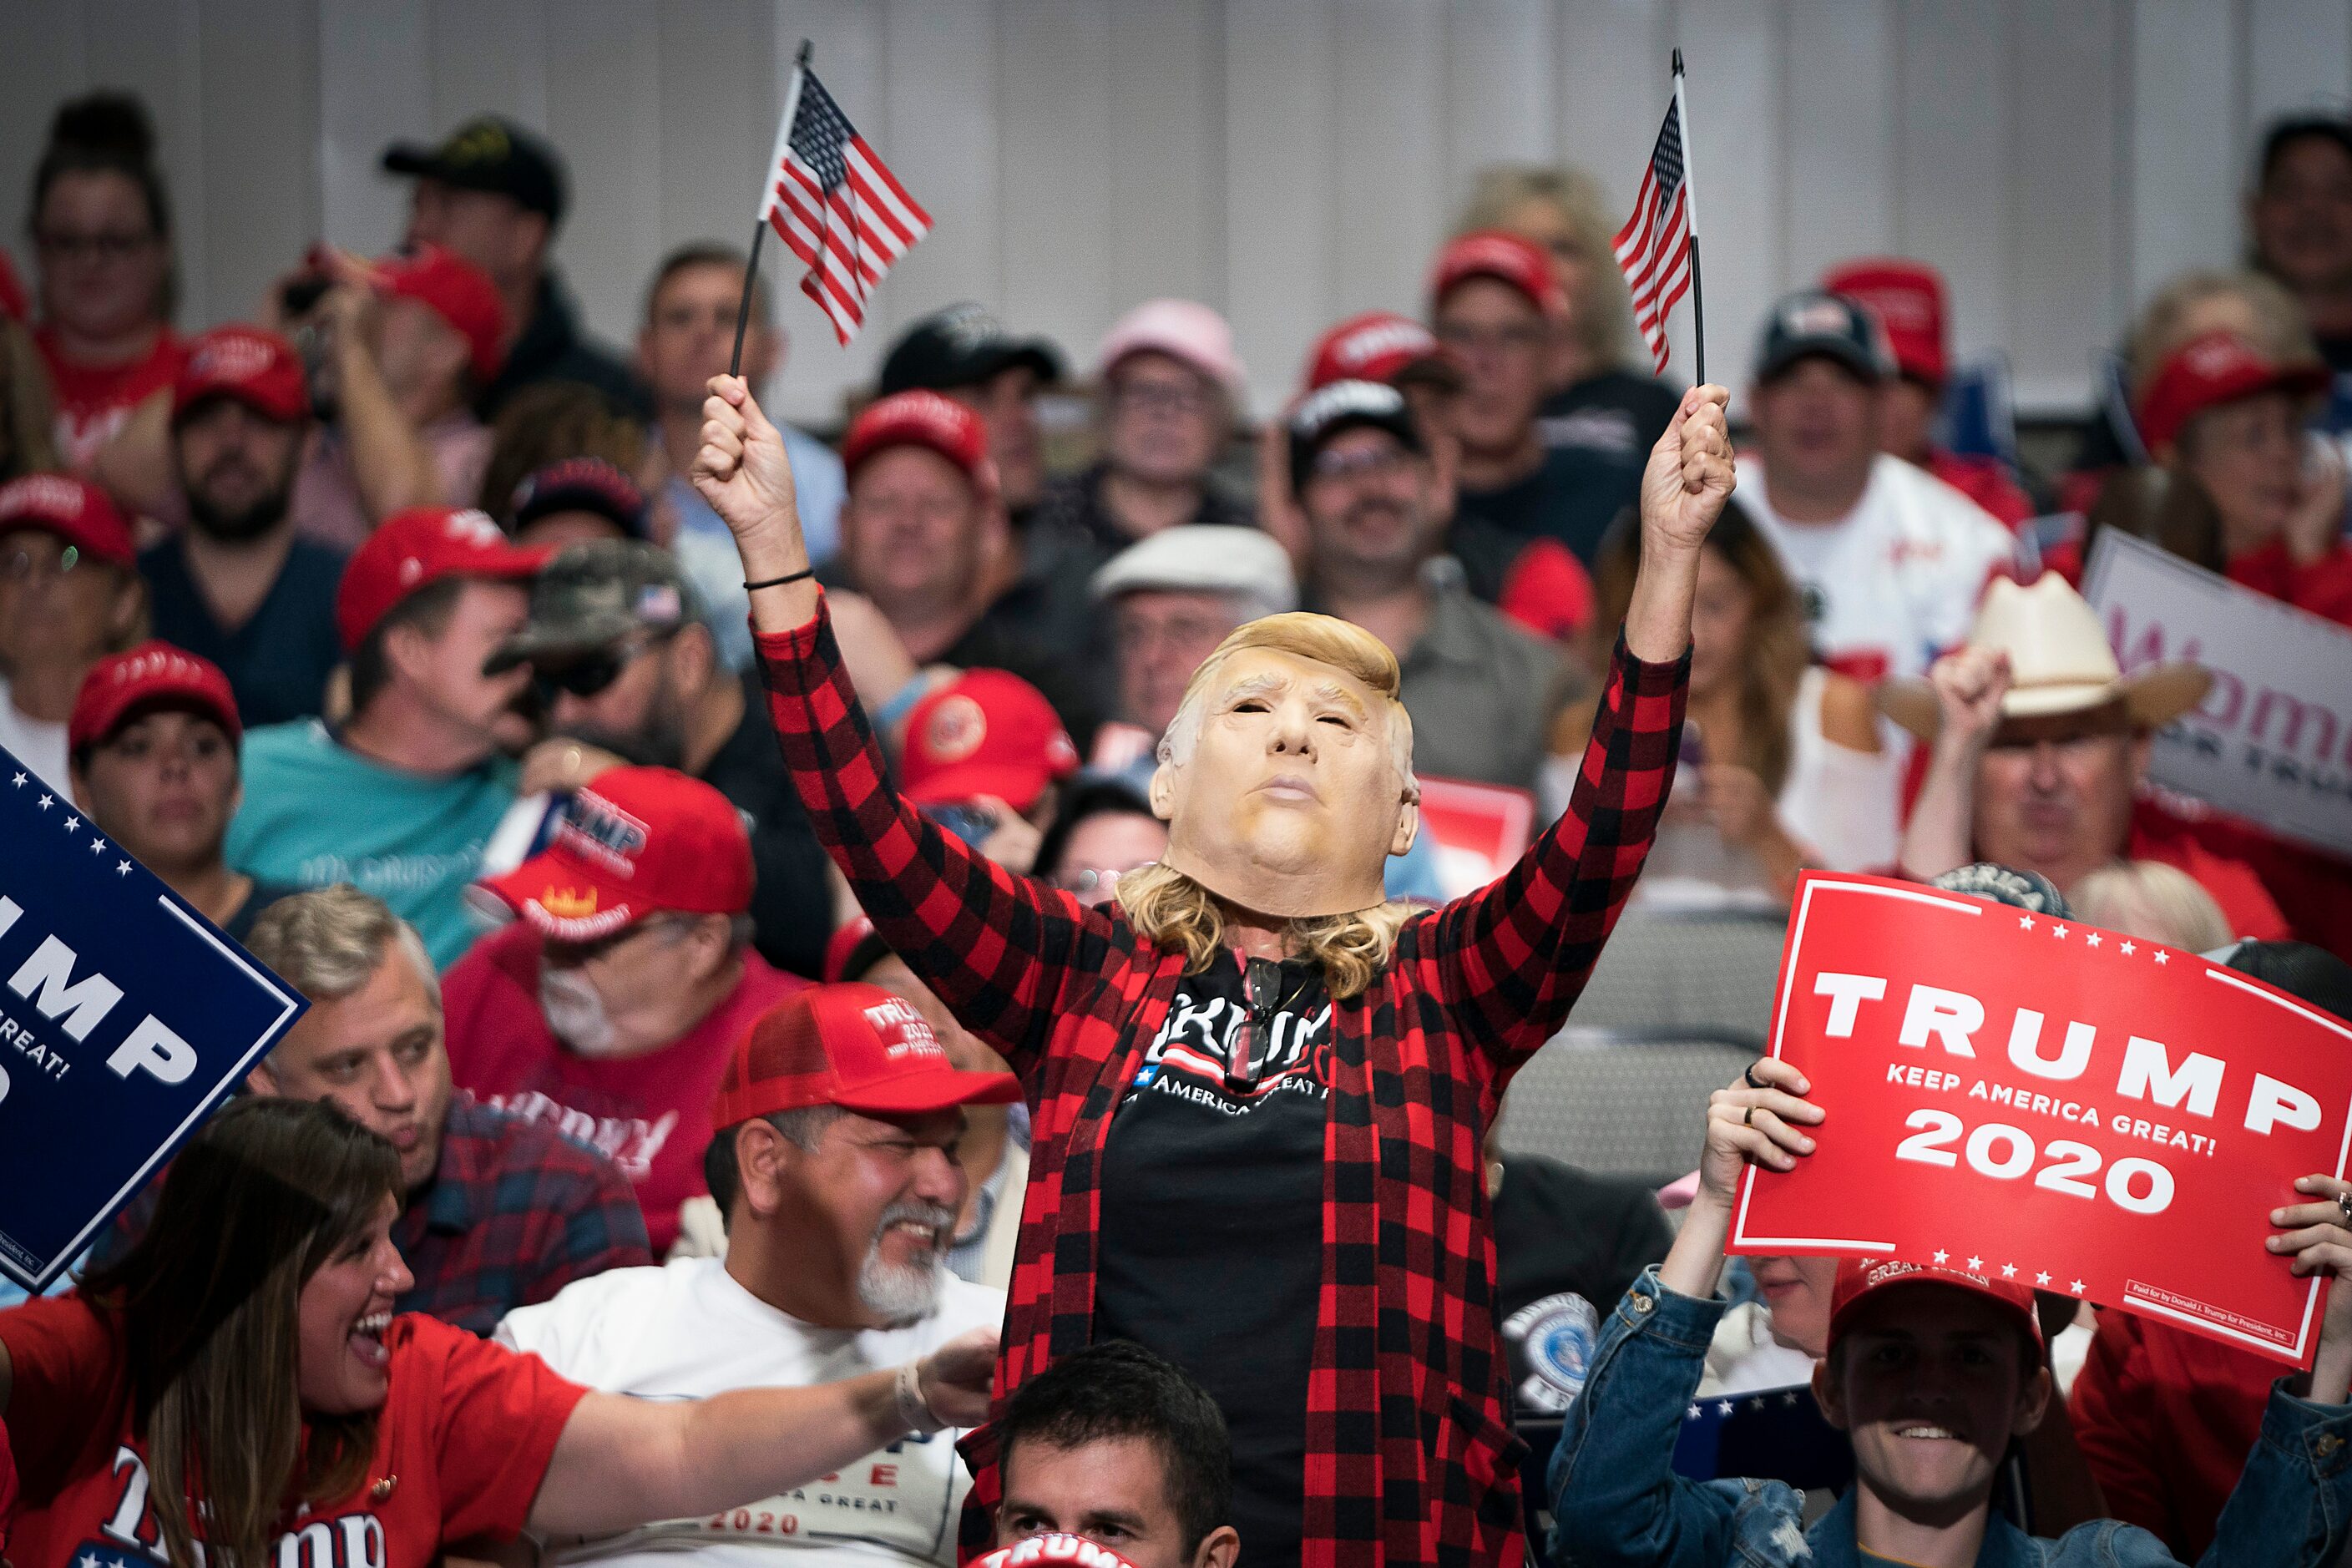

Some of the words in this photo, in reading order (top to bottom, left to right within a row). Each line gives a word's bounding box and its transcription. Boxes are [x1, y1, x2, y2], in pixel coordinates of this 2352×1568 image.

[0, 1009, 71, 1080] REAT!
[1813, 972, 2323, 1136] TRUMP
[1153, 1074, 1251, 1115] AMERICA
[1886, 1064, 1960, 1091] KEEP
[1969, 1080, 2100, 1126] AMERICA
[2112, 1115, 2218, 1157] GREAT!
[1896, 1109, 2176, 1215] 2020
[2133, 1284, 2149, 1295] Paid
[2150, 1288, 2160, 1297] for
[2161, 1292, 2170, 1302] by
[2171, 1295, 2197, 1310] Donald
[2203, 1307, 2227, 1320] Trump
[2228, 1313, 2238, 1323] for
[2238, 1317, 2274, 1336] President,
[709, 1508, 799, 1536] 2020
[819, 1493, 898, 1513] GREAT
[981, 1536, 1132, 1568] TRUM
